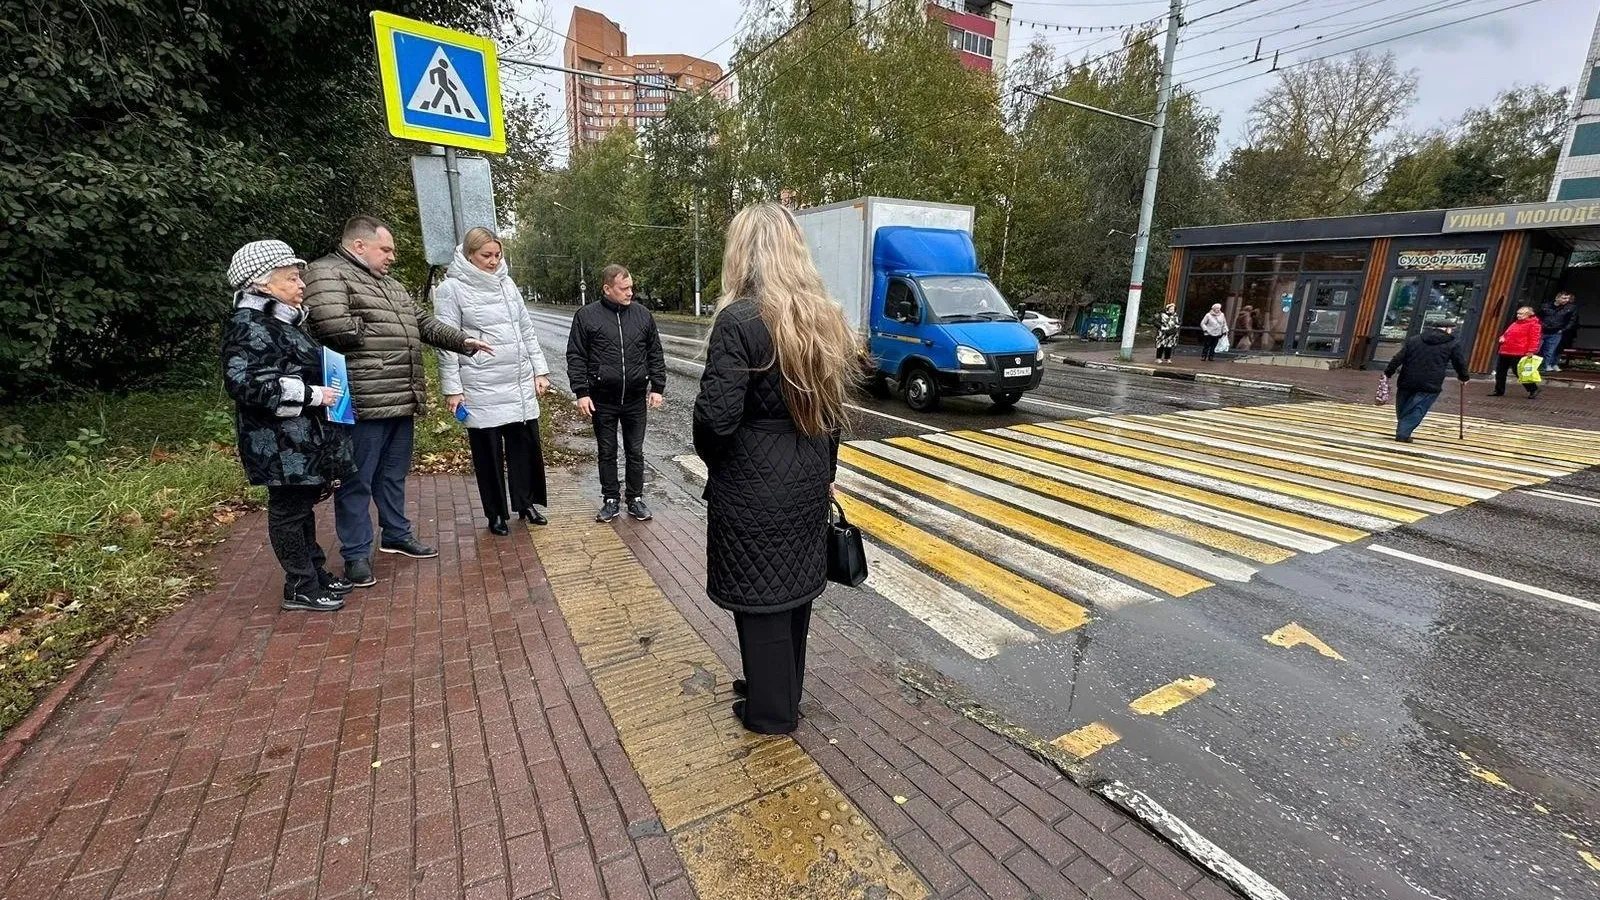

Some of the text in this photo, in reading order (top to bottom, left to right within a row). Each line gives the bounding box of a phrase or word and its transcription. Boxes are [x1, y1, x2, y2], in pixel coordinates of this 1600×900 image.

[1449, 203, 1600, 228] УЛИЦА МОЛОДЁ
[1398, 253, 1486, 266] СУХОФРУКТЫ
